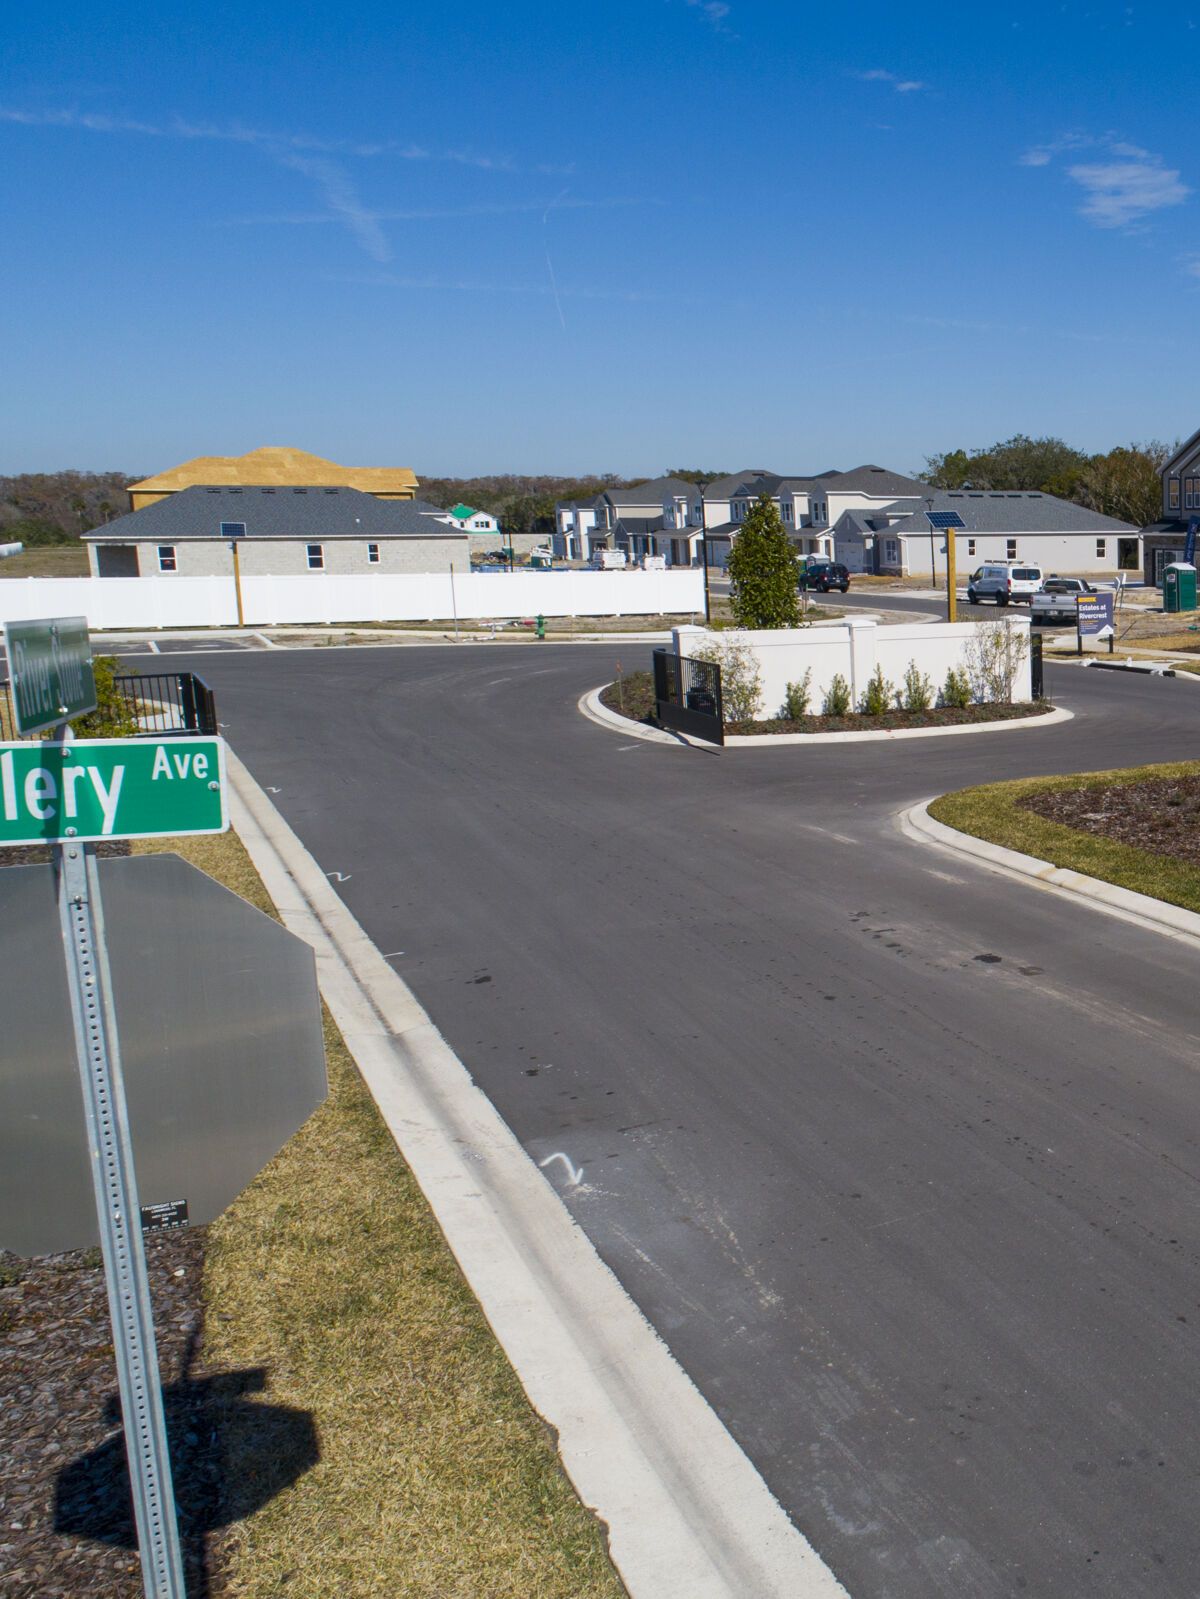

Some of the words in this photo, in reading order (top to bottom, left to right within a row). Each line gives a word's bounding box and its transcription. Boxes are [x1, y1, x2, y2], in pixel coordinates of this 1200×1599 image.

[14, 638, 53, 718] River
[0, 750, 125, 835] lery
[152, 745, 208, 781] Ave
